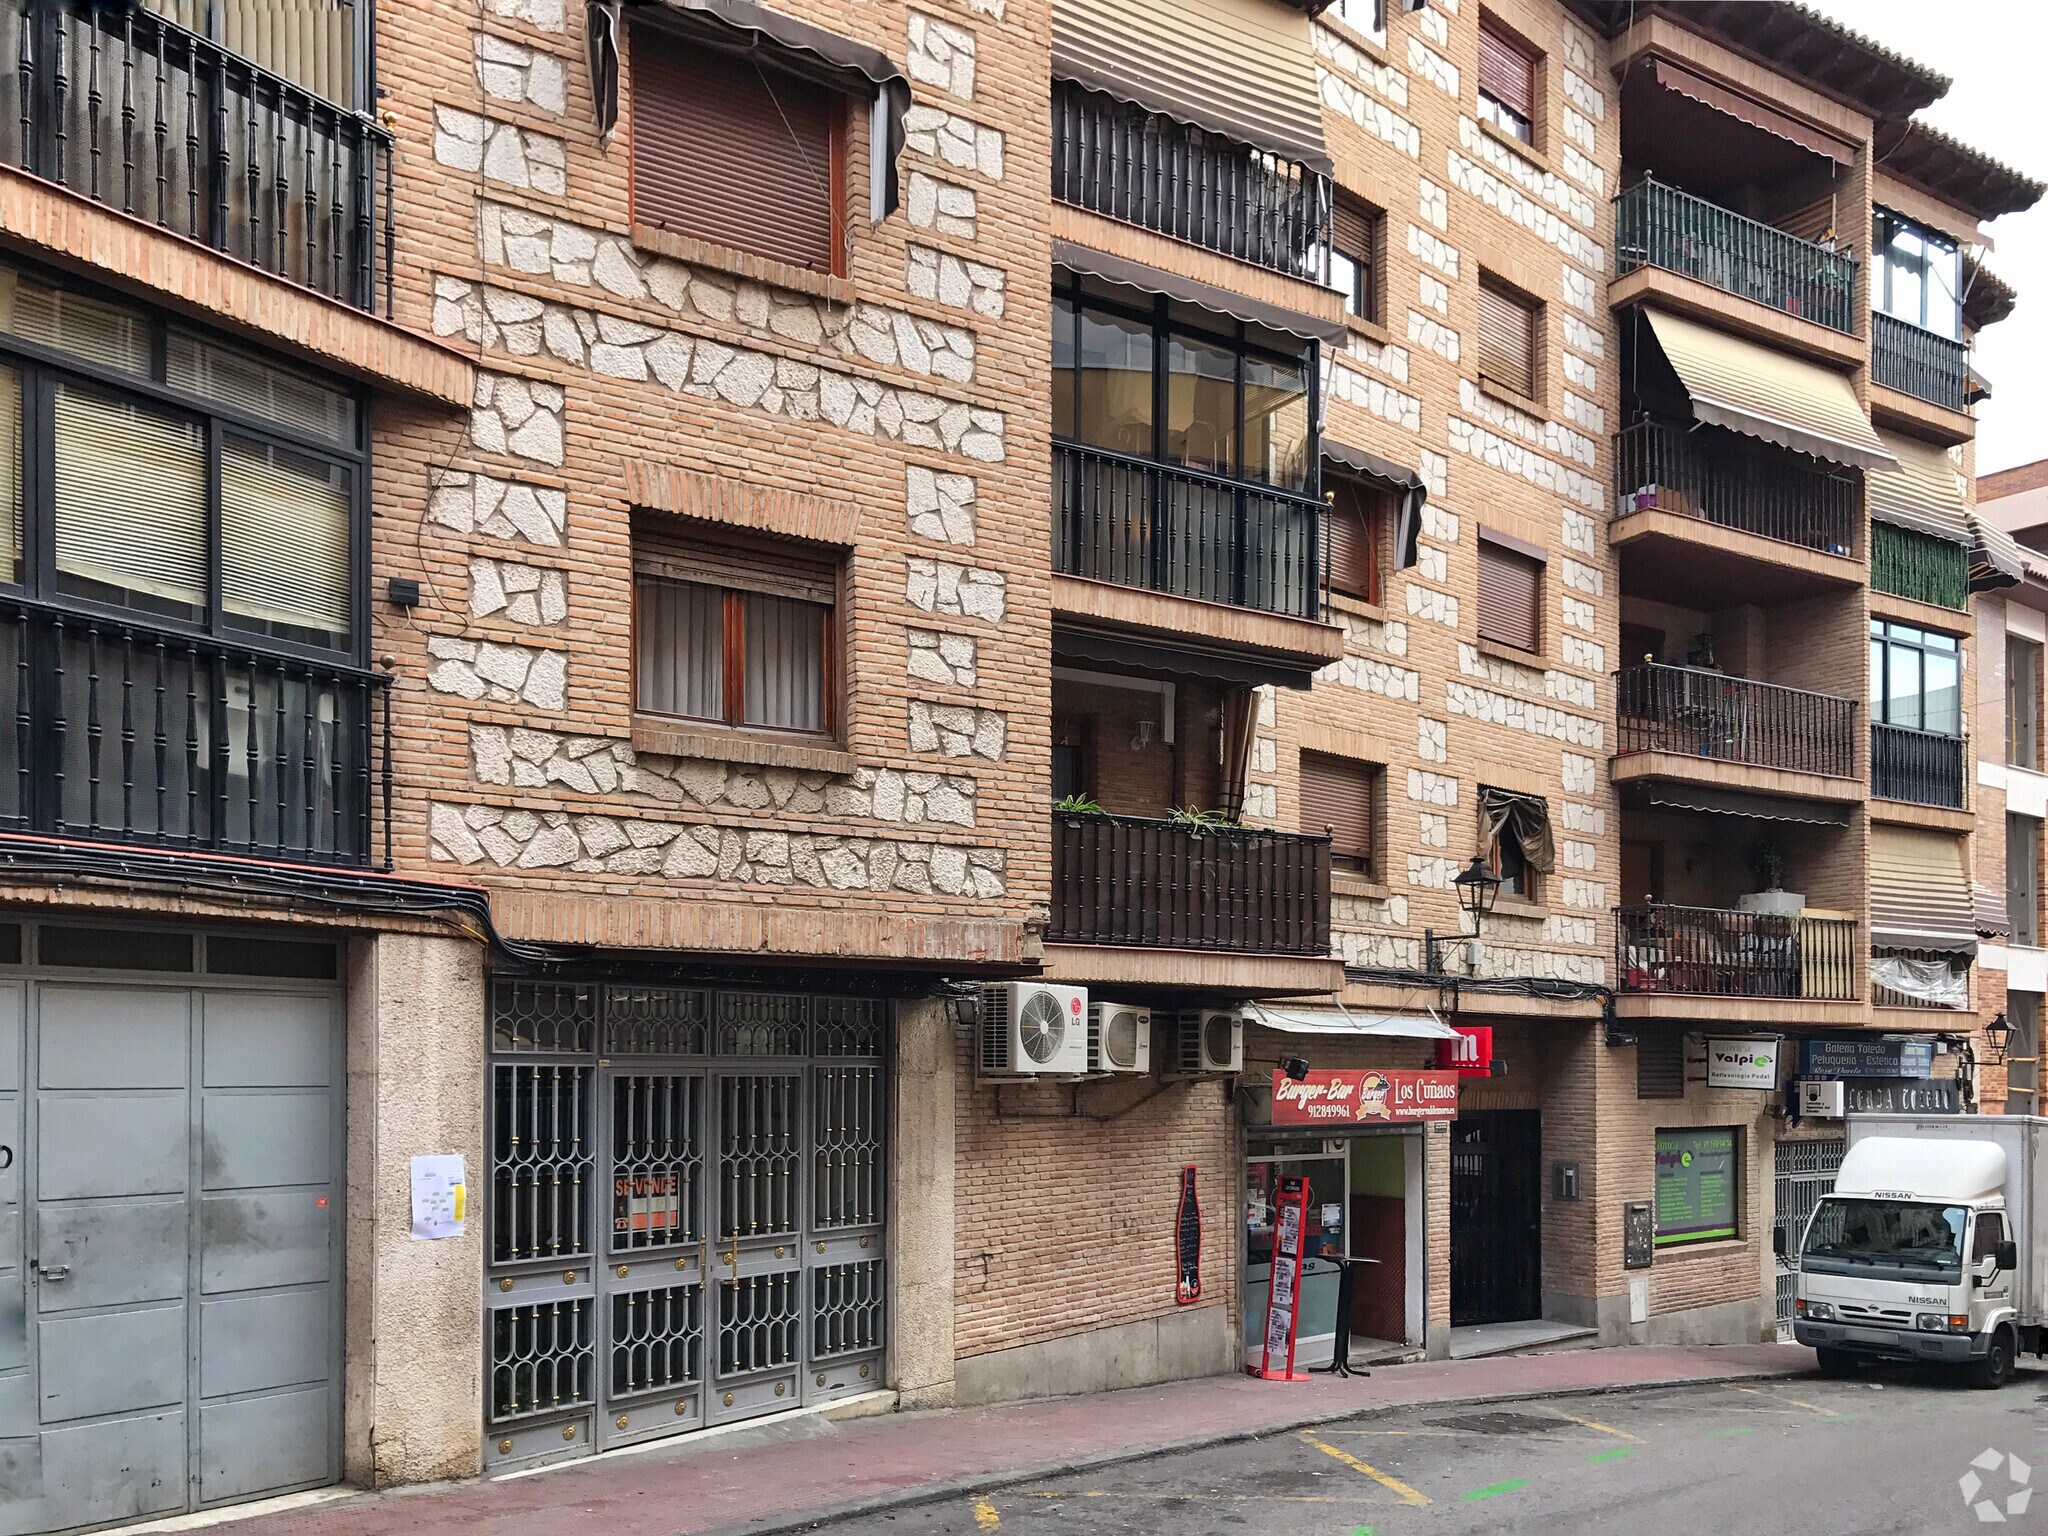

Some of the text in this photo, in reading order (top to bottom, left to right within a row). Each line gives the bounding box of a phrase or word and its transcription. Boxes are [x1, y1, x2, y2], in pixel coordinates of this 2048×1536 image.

[1071, 1018, 1080, 1026] LG
[1857, 1043, 1886, 1054] Toledo
[1715, 1052, 1769, 1068] Valpie
[1276, 1077, 1354, 1110] Burger-Bar
[1361, 1087, 1385, 1102] Burger
[1394, 1078, 1456, 1104] Los Cuñaos
[1307, 1104, 1350, 1118] 912849961
[1874, 1191, 1912, 1200] NISSAN
[1908, 1296, 1948, 1306] NISSAN
